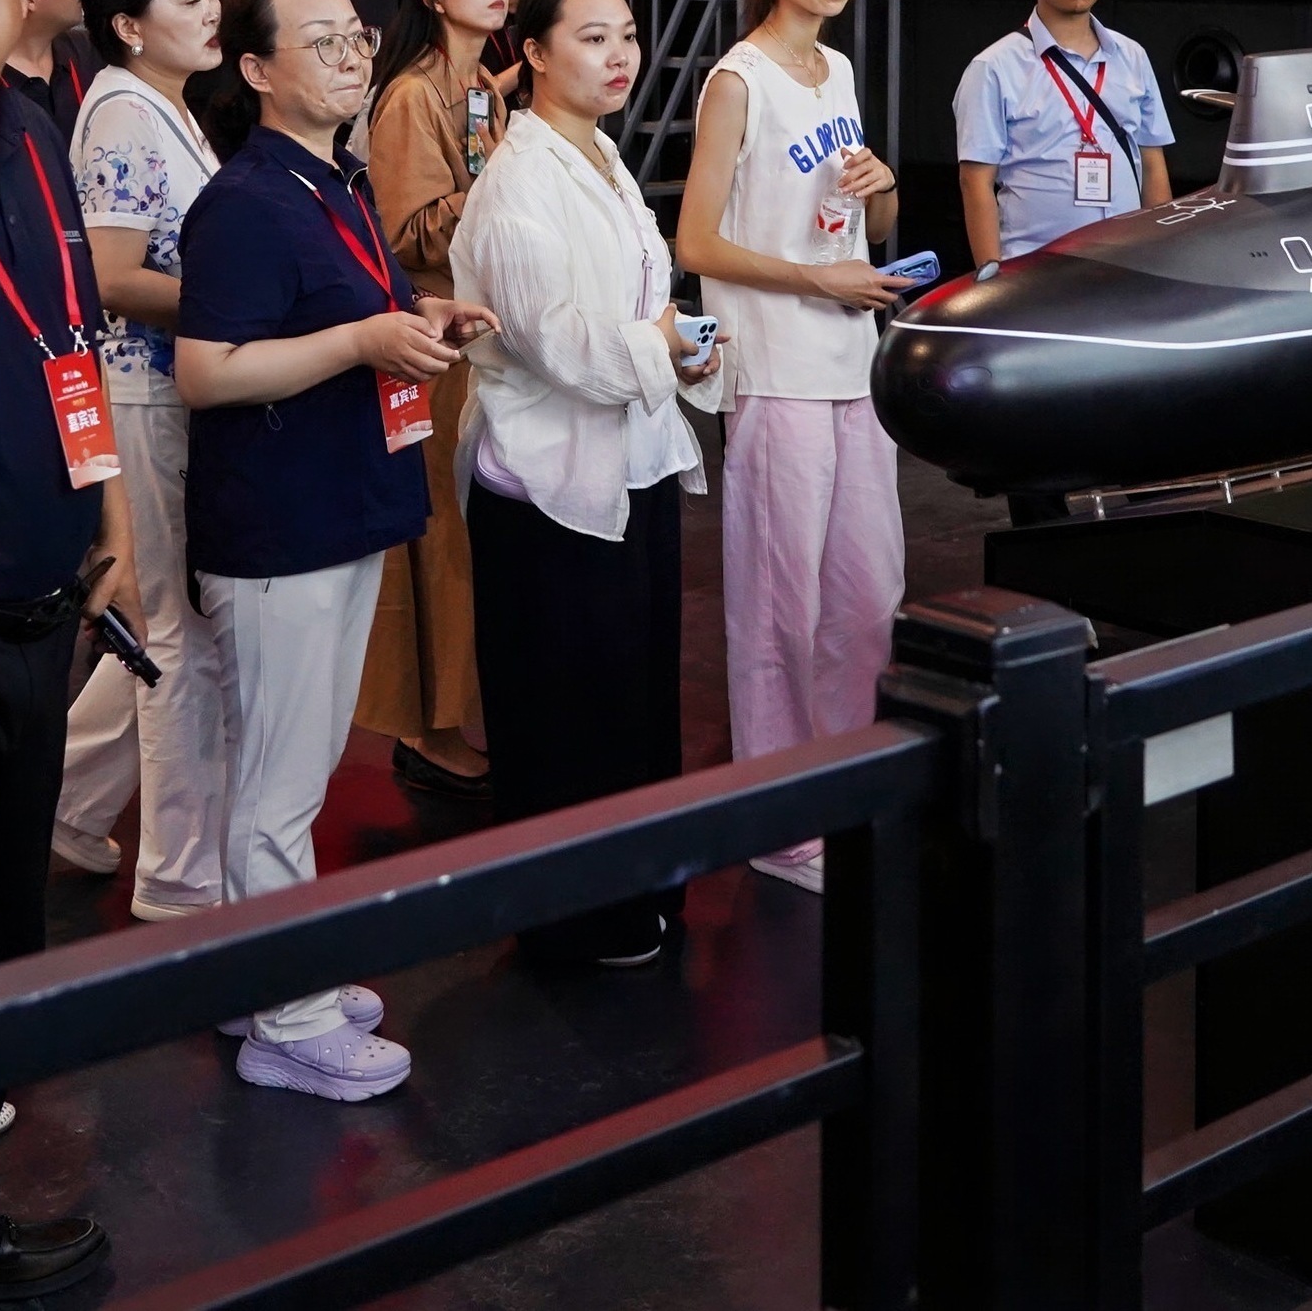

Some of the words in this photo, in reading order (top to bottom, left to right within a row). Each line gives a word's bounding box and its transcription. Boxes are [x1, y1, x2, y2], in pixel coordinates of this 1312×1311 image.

[389, 384, 419, 410] 嘉宾证
[66, 406, 101, 433] 嘉宾证
